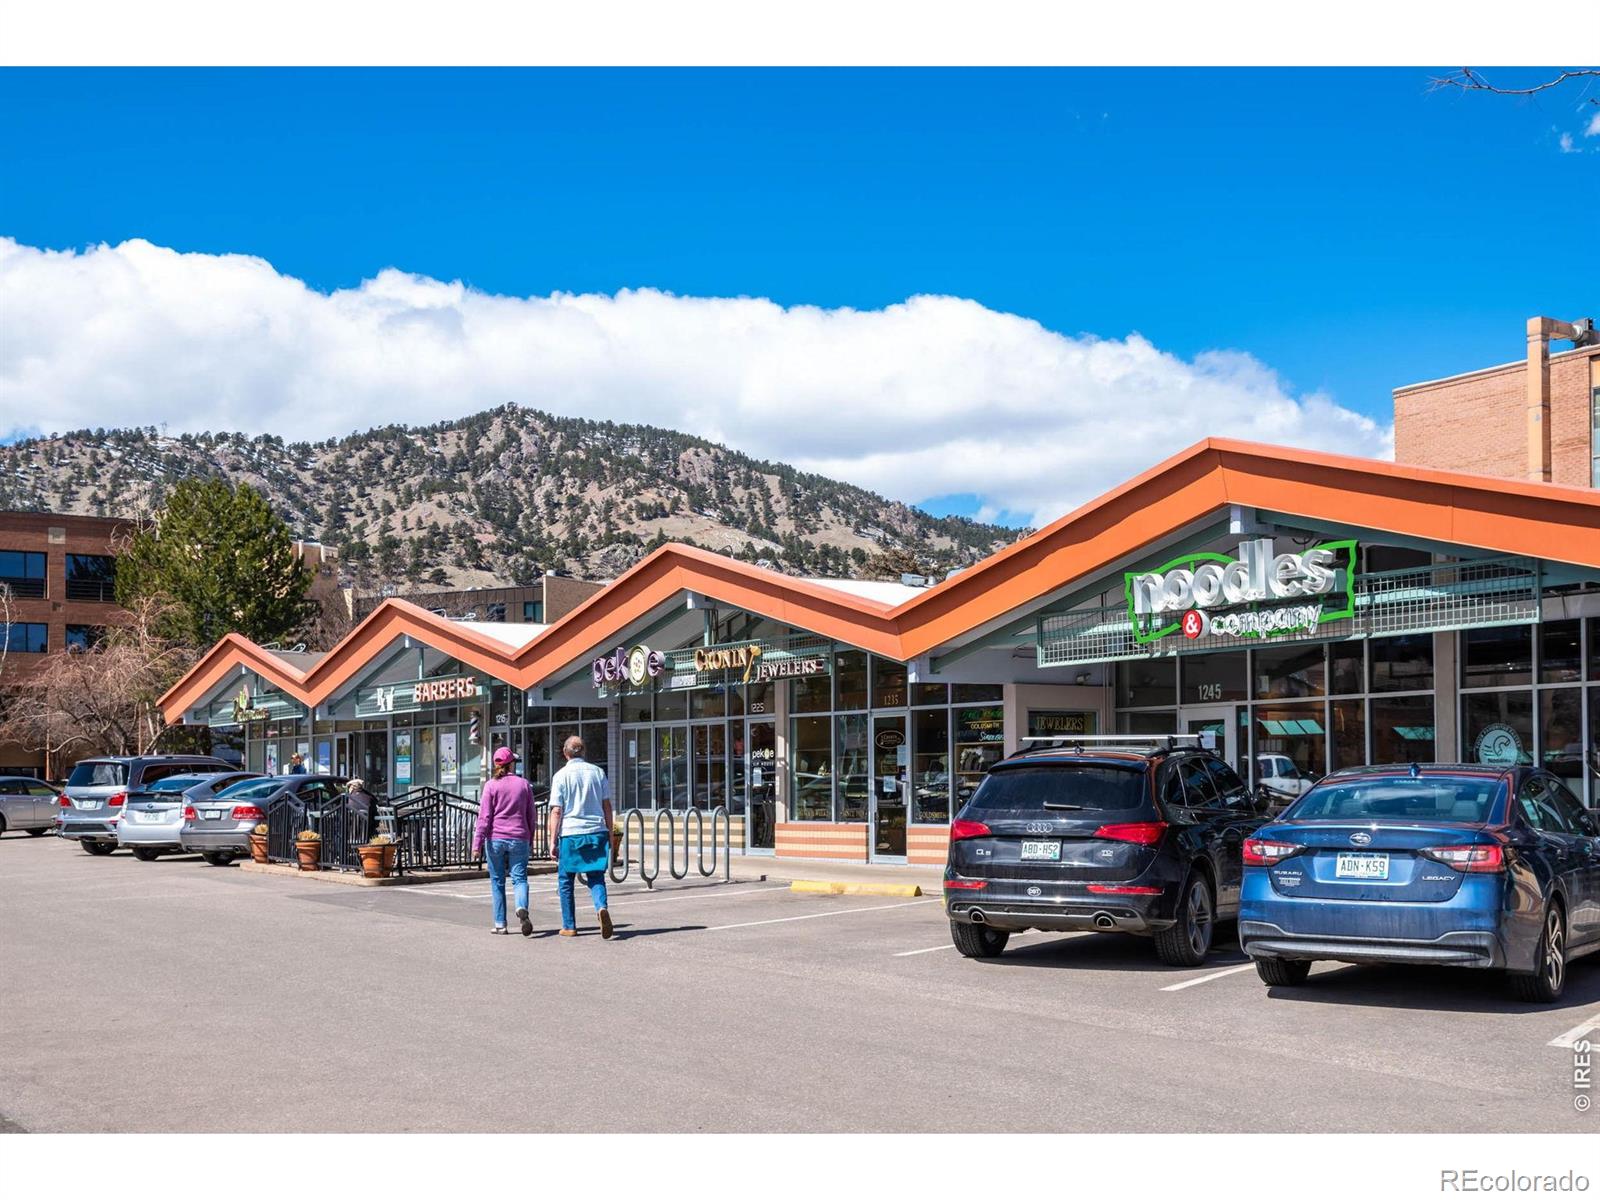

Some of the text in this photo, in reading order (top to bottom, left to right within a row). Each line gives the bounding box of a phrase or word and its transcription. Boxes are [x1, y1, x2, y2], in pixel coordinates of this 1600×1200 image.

[1133, 539, 1337, 614] noodles
[1210, 604, 1323, 639] company
[755, 659, 818, 681] JEWELERS
[413, 677, 475, 703] BARBERS
[884, 695, 899, 705] 1235
[1198, 684, 1221, 700] 1245
[1035, 716, 1084, 731] JEWELERS
